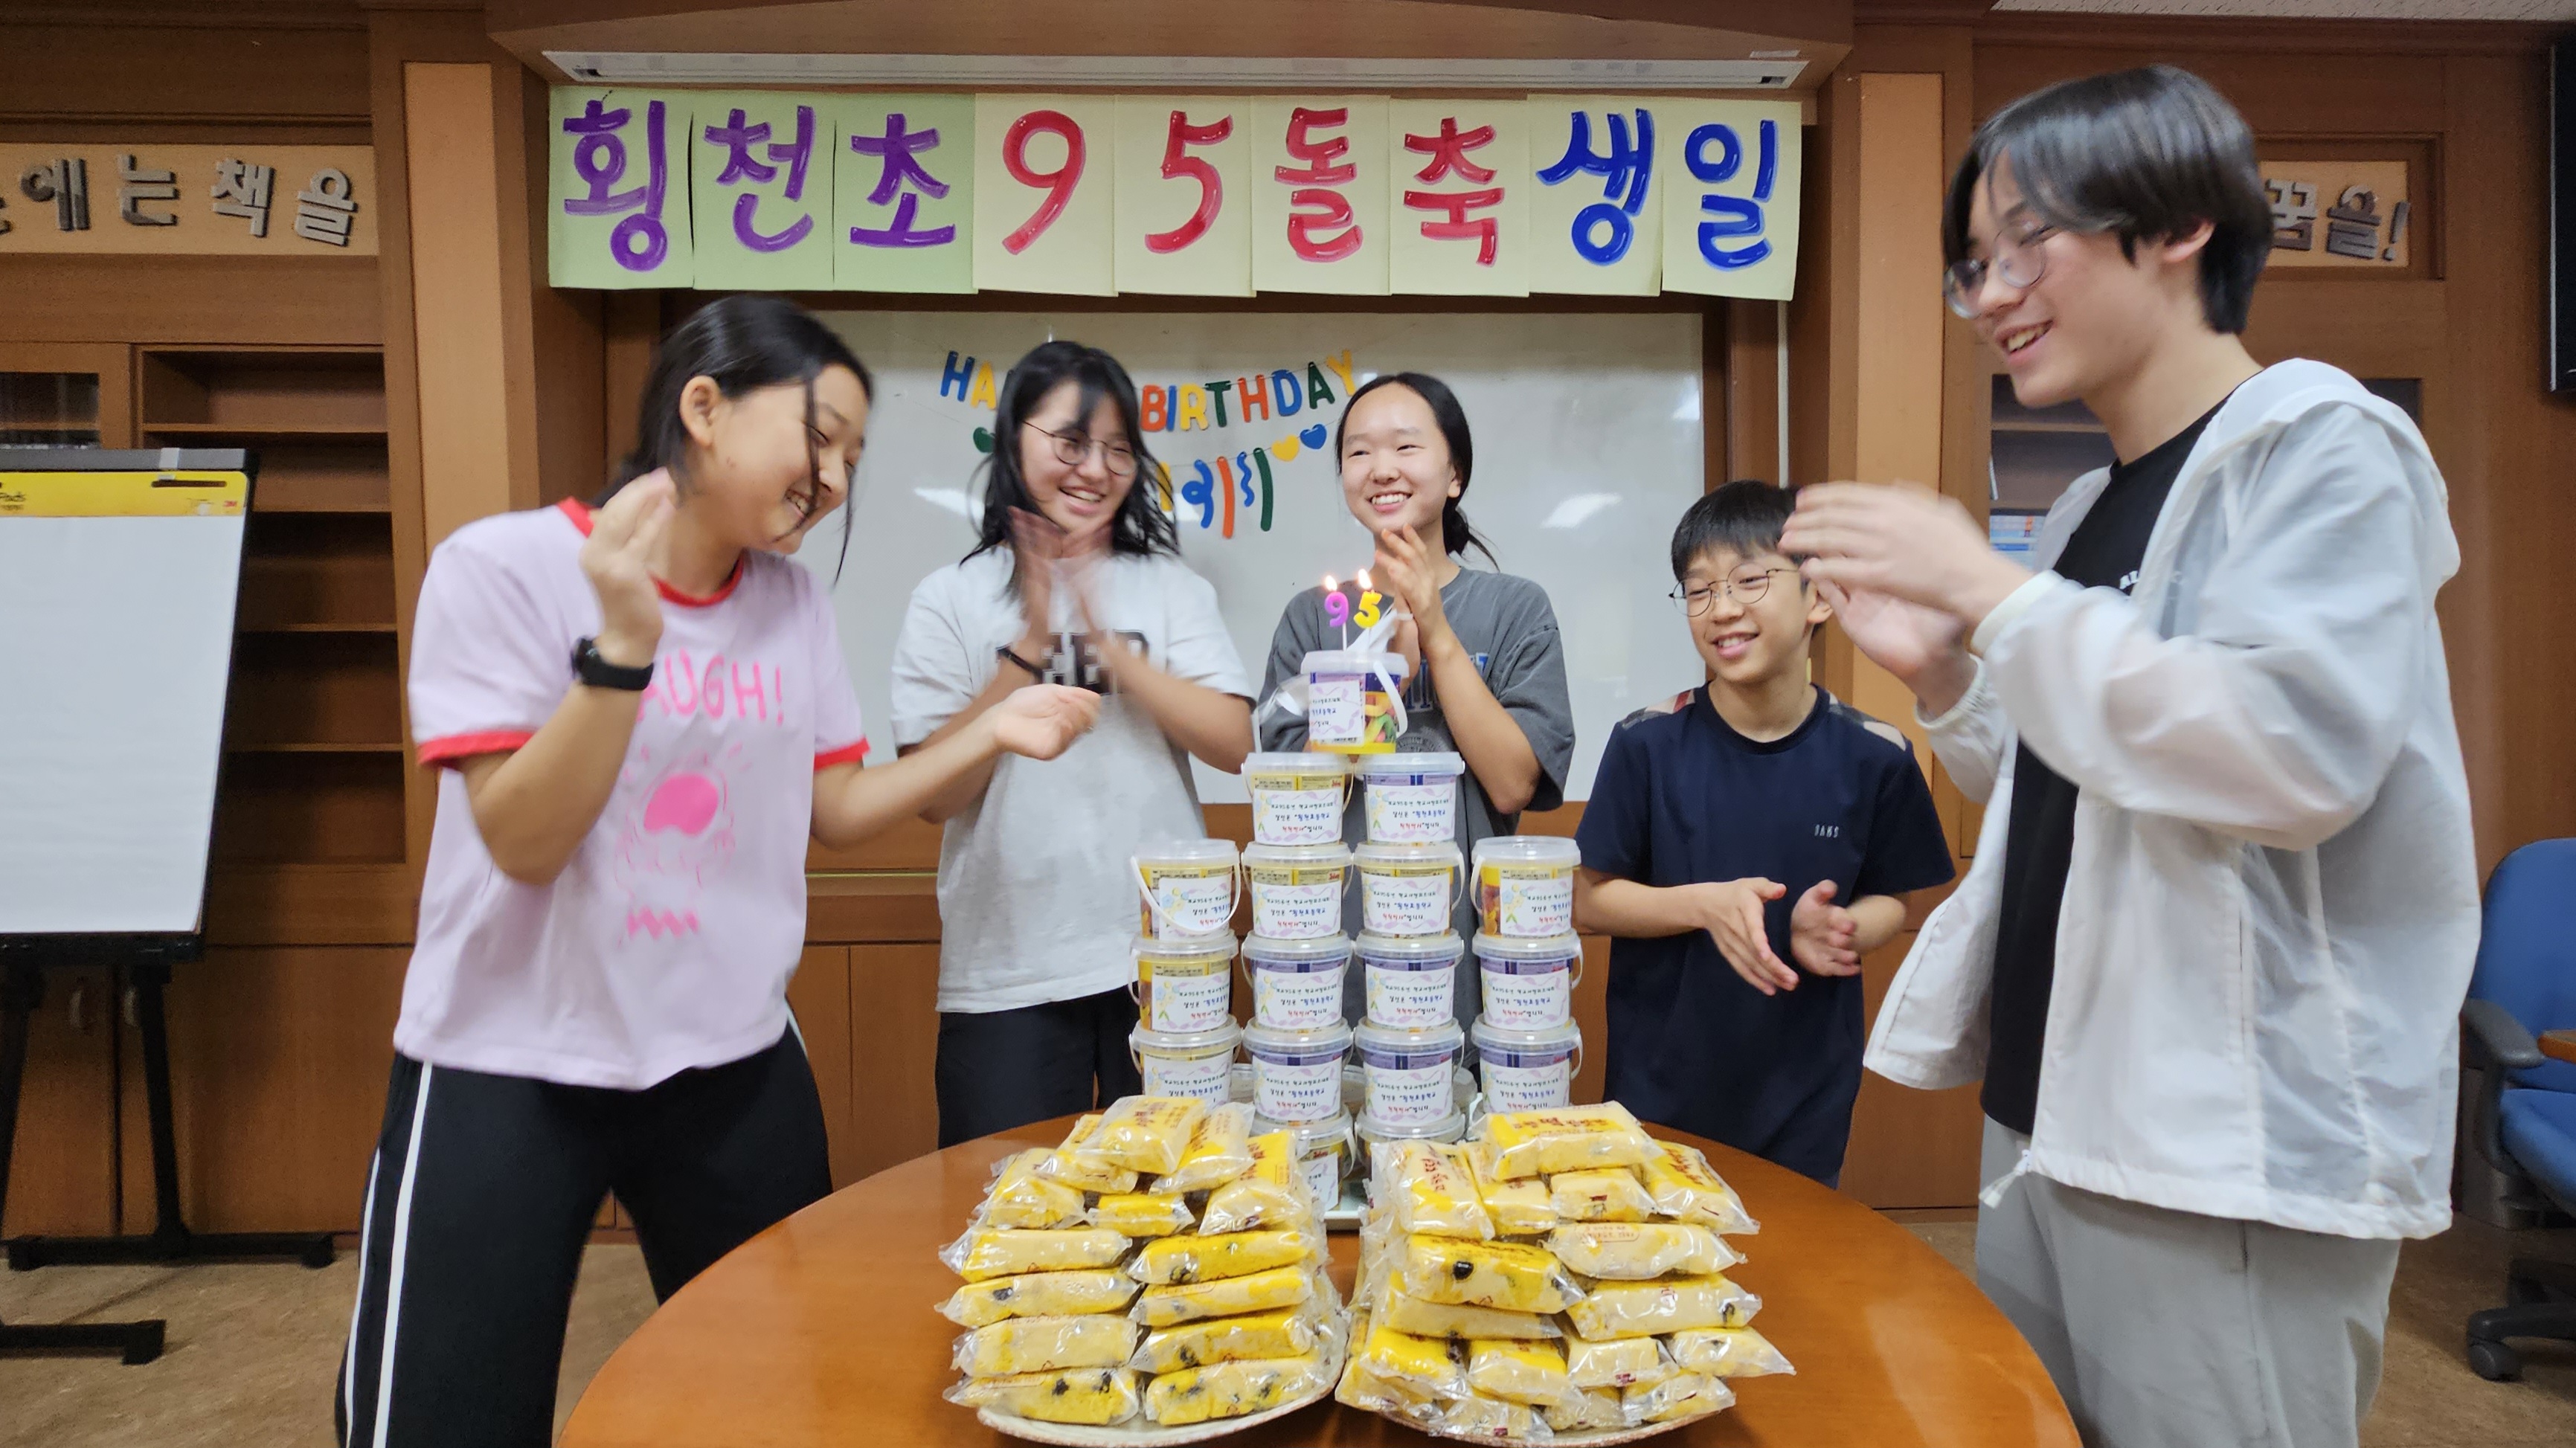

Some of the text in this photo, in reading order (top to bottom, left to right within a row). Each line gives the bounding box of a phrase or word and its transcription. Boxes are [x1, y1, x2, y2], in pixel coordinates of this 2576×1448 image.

[0, 154, 359, 247] 에는 책을
[1140, 350, 1355, 432] BIRTHDAY
